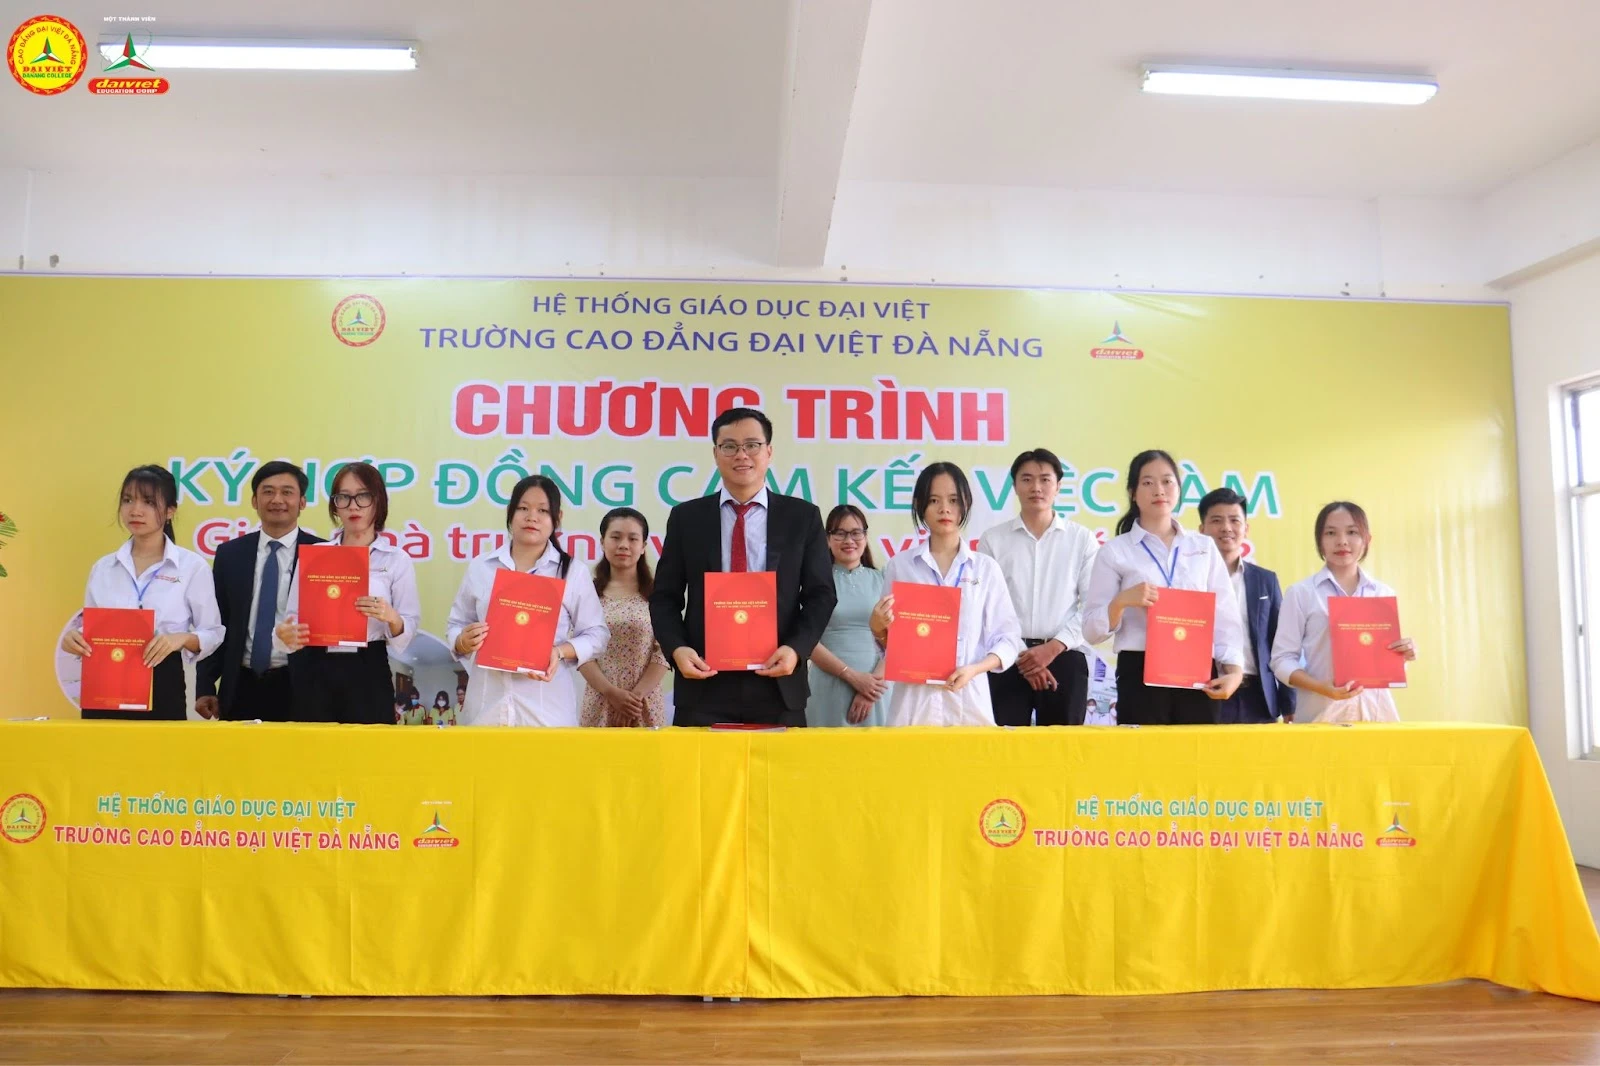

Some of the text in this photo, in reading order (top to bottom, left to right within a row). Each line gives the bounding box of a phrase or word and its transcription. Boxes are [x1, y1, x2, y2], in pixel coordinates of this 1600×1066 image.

[533, 291, 930, 322] HỆ THỐNG GIÁO DỤC ĐẠI VIỆT
[420, 322, 1043, 358] TRƯỜNG CAO ĐẲNG ĐẠI VIỆT ĐÀ NẴNG
[787, 379, 1004, 441] TRÌNH
[172, 451, 256, 502] KÝ
[658, 465, 813, 508] CM
[838, 453, 921, 510] KẾ
[98, 791, 355, 822] HỆ THỐNG GIÁO DỤC ĐẠI VIỆT
[1077, 794, 1323, 821] HỆ THỐNG GIÁO DỤC ĐẠI VIỆT
[54, 820, 400, 853] TRƯỜNG CAO ĐẲNG ĐẠI VIỆT ĐÀ NẴNG
[1115, 831, 1150, 847] CAO
[1156, 822, 1204, 847] ĐẲNG
[1210, 831, 1238, 852] ĐẠI
[1245, 828, 1282, 852] VIỆT
[1288, 828, 1310, 847] ĐÀ
[1317, 824, 1363, 848] NẴNG
